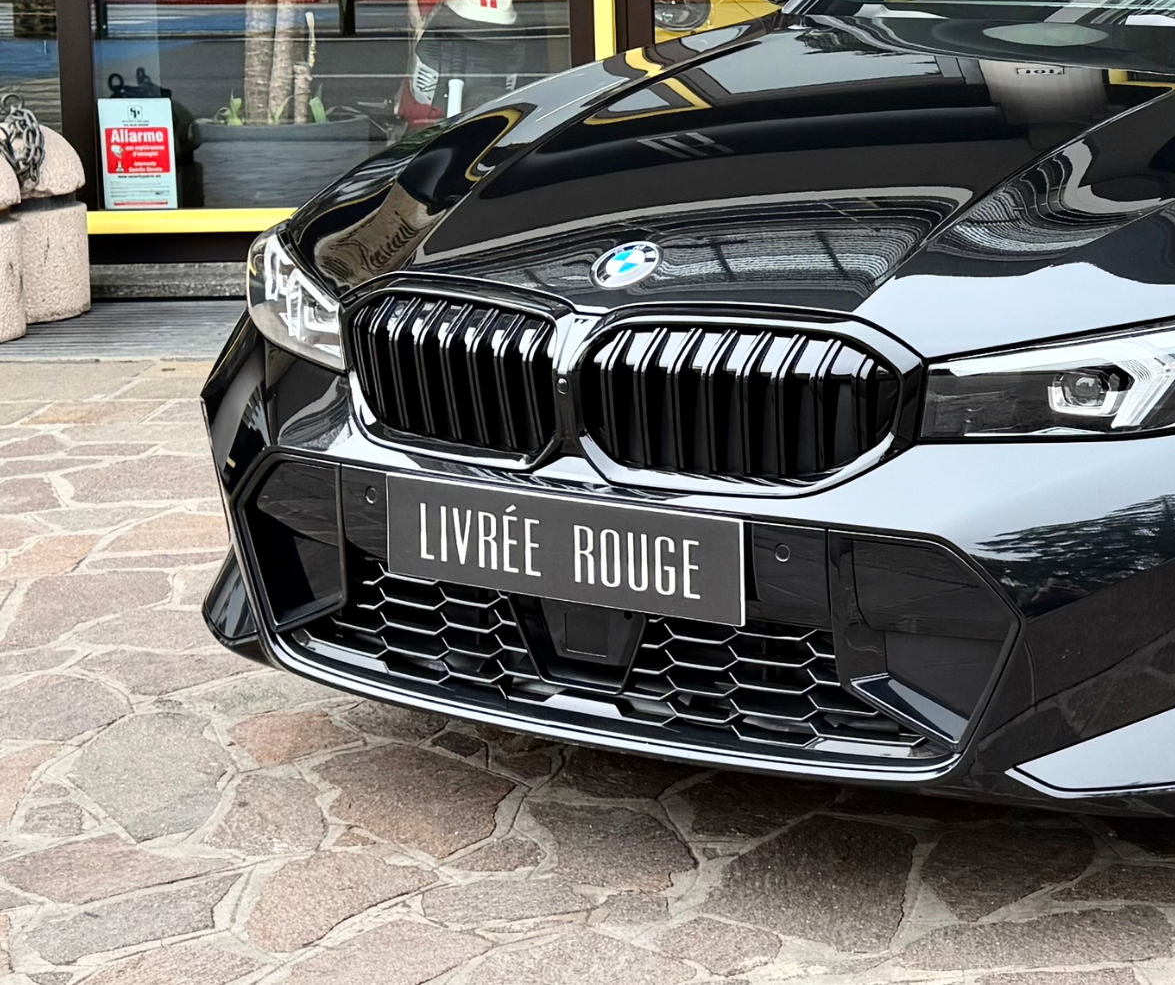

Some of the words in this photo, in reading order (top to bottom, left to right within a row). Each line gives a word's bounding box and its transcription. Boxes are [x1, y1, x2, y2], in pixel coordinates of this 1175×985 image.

[110, 128, 164, 143] Allarme
[419, 502, 542, 577] LIVRÉE
[573, 524, 701, 600] ROUGE
